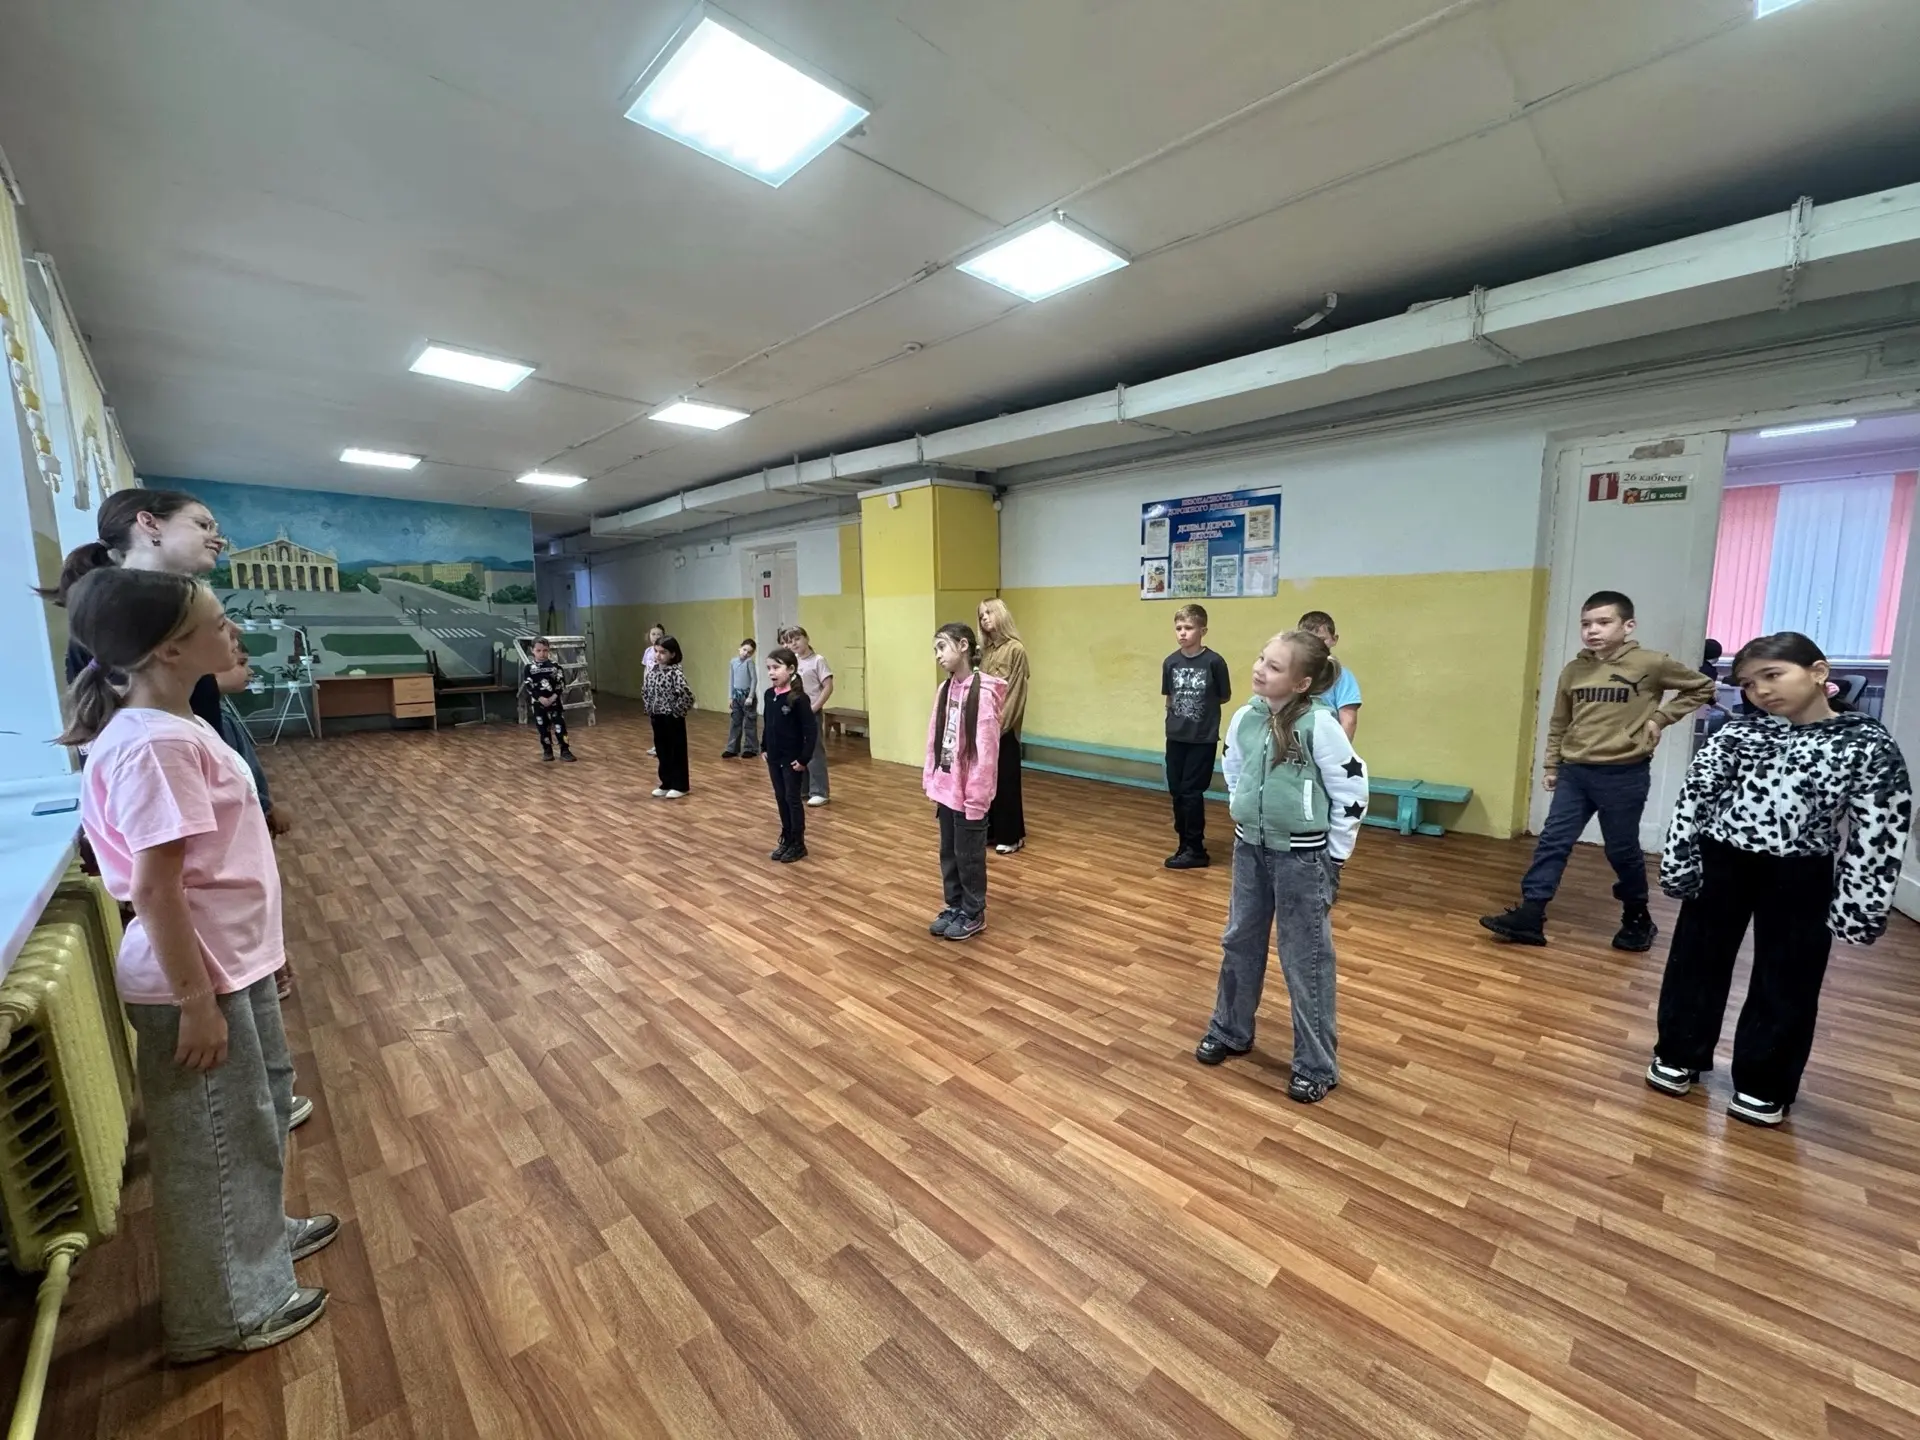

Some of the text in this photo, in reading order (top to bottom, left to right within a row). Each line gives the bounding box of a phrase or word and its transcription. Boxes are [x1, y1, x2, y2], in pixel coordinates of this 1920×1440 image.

[1624, 473, 1683, 482] 26 кабинет
[1573, 688, 1629, 703] PUMA
